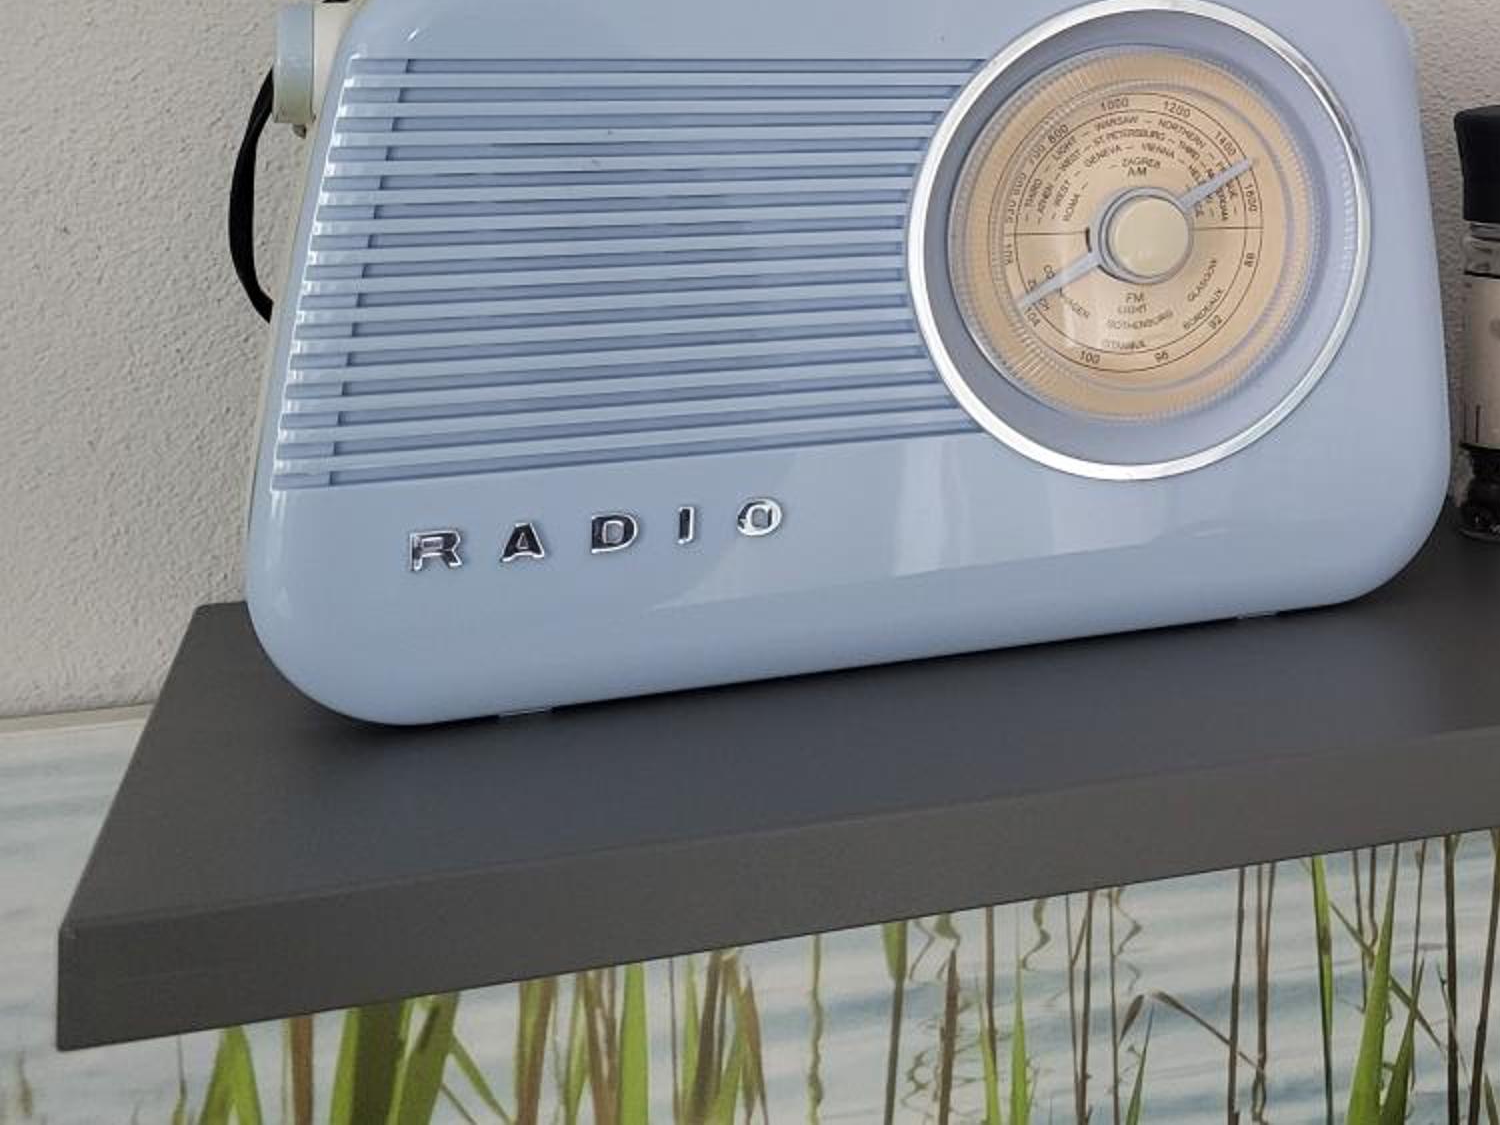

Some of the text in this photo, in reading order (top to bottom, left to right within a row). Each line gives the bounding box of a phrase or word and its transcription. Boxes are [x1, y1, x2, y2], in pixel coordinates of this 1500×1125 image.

[1048, 124, 1069, 144] 800
[1101, 97, 1129, 112] 1000
[1163, 100, 1191, 118] 1200
[1215, 131, 1237, 156] 1400
[1052, 136, 1076, 160] LIGHT
[1095, 115, 1139, 131] WARSAW
[1158, 118, 1206, 150] NORTHERN
[1084, 144, 1123, 168] GENEVA
[1141, 142, 1175, 159] VIENNA
[1127, 167, 1147, 176] AM
[1126, 292, 1145, 304] FM
[1183, 289, 1222, 330] BORDEAUX
[1024, 307, 1041, 327] 104
[1080, 350, 1101, 364] 100
[1154, 350, 1169, 362] 96
[1208, 315, 1223, 329] 92
[410, 498, 783, 572] RADIO
